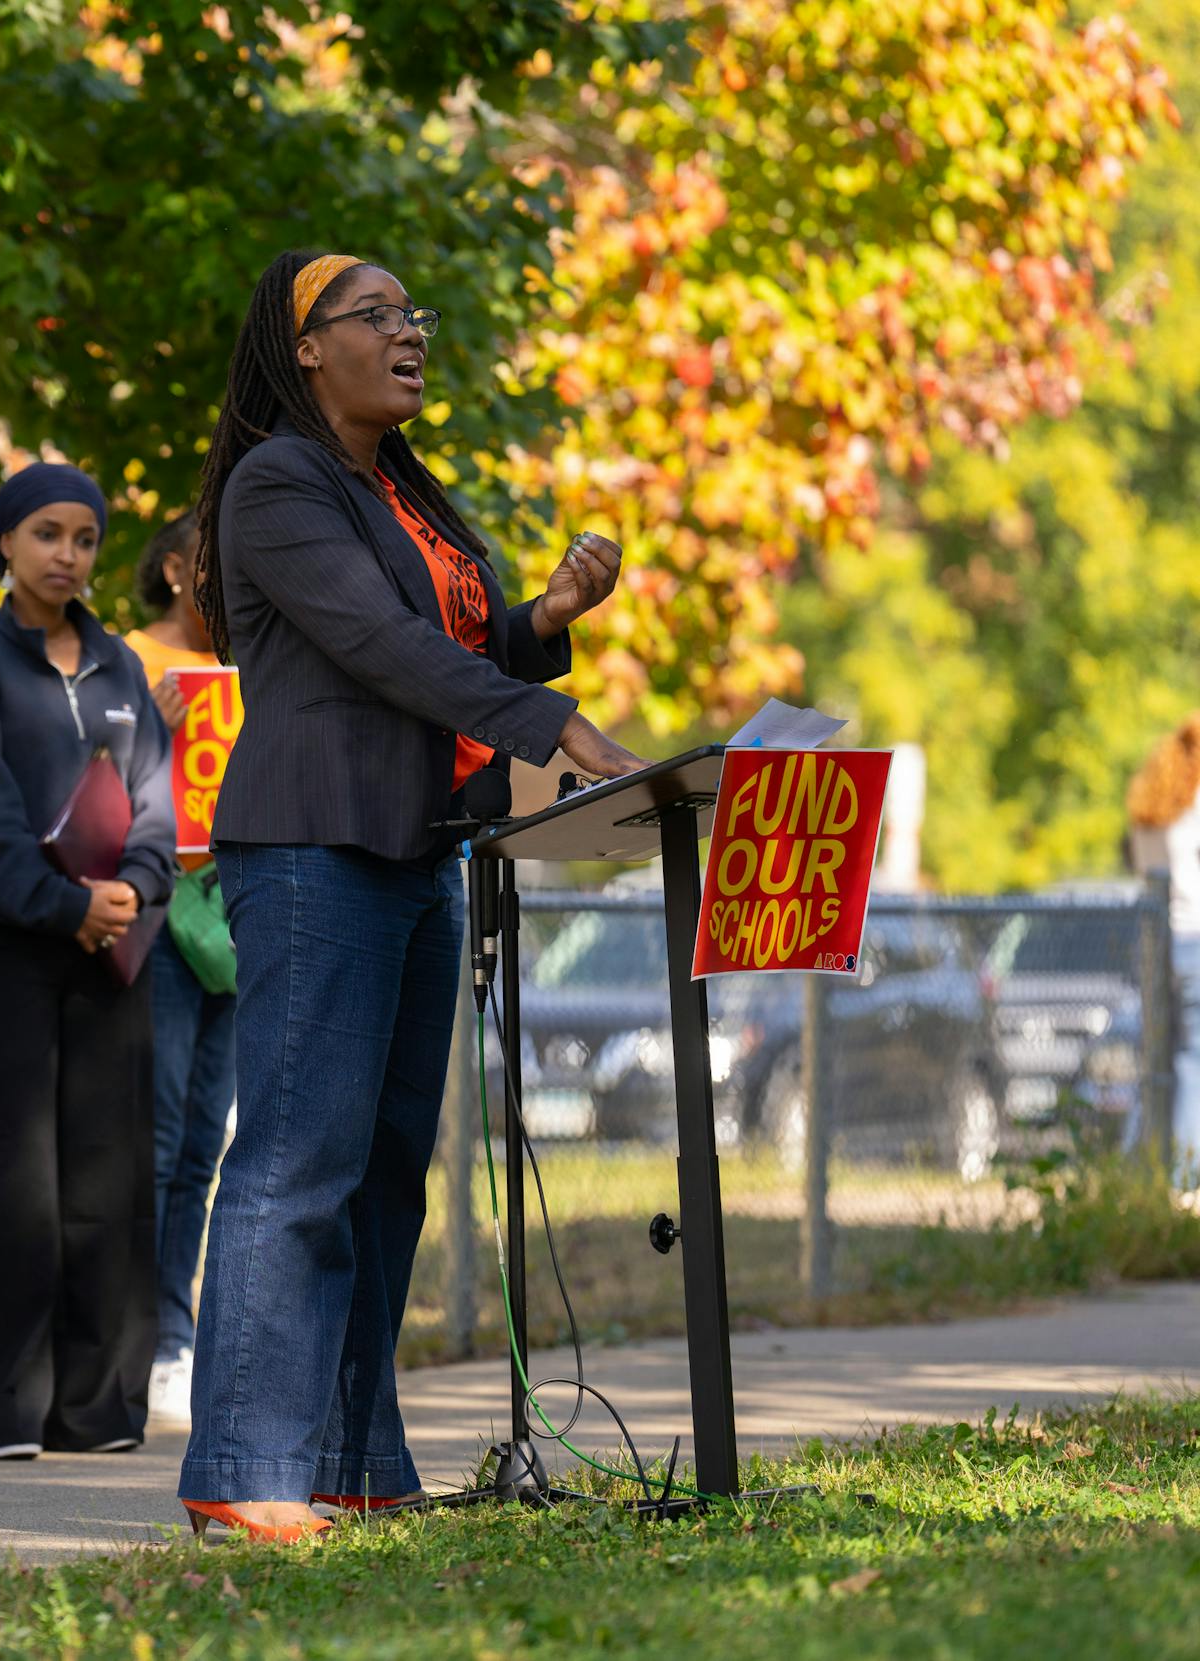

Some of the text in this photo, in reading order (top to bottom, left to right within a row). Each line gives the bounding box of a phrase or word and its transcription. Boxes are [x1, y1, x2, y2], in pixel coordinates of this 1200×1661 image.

[726, 753, 859, 837] FUND
[717, 838, 846, 897] OUR
[709, 898, 842, 969] SCHOOLS
[813, 951, 856, 971] AROS
